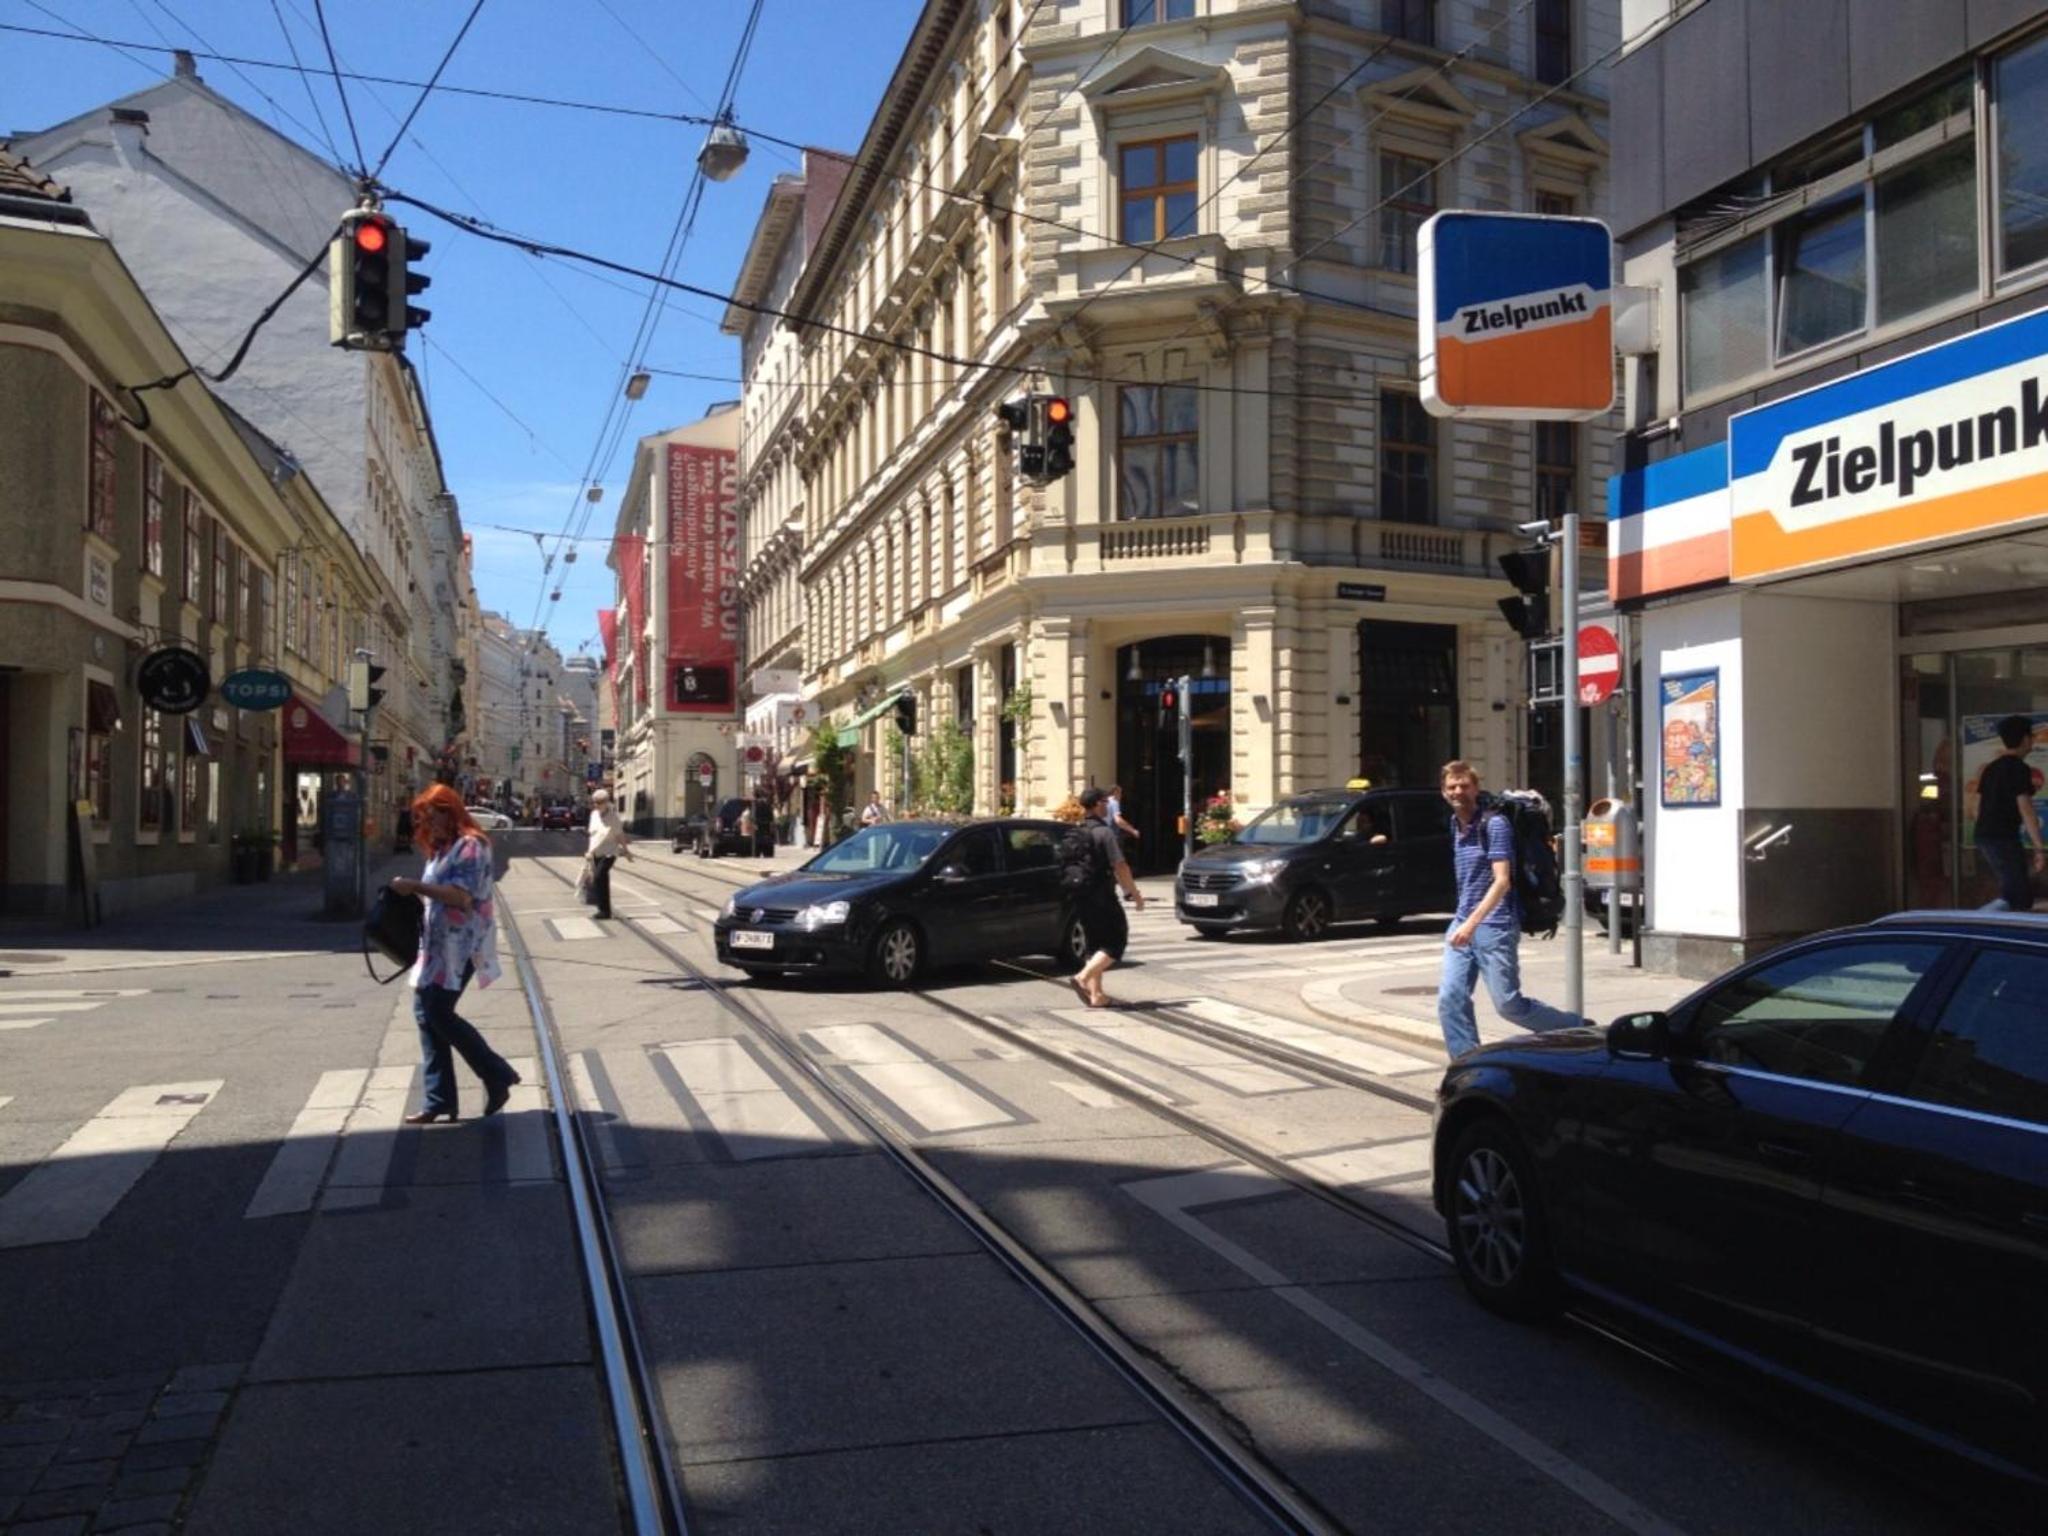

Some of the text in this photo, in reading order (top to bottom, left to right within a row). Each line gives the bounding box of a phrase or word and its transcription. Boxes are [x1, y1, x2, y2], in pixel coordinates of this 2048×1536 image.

[1462, 292, 1587, 334] Zielpunkt
[671, 452, 685, 556] Romantische
[701, 502, 715, 534] den
[701, 540, 715, 593] haben
[701, 599, 715, 628] Wir
